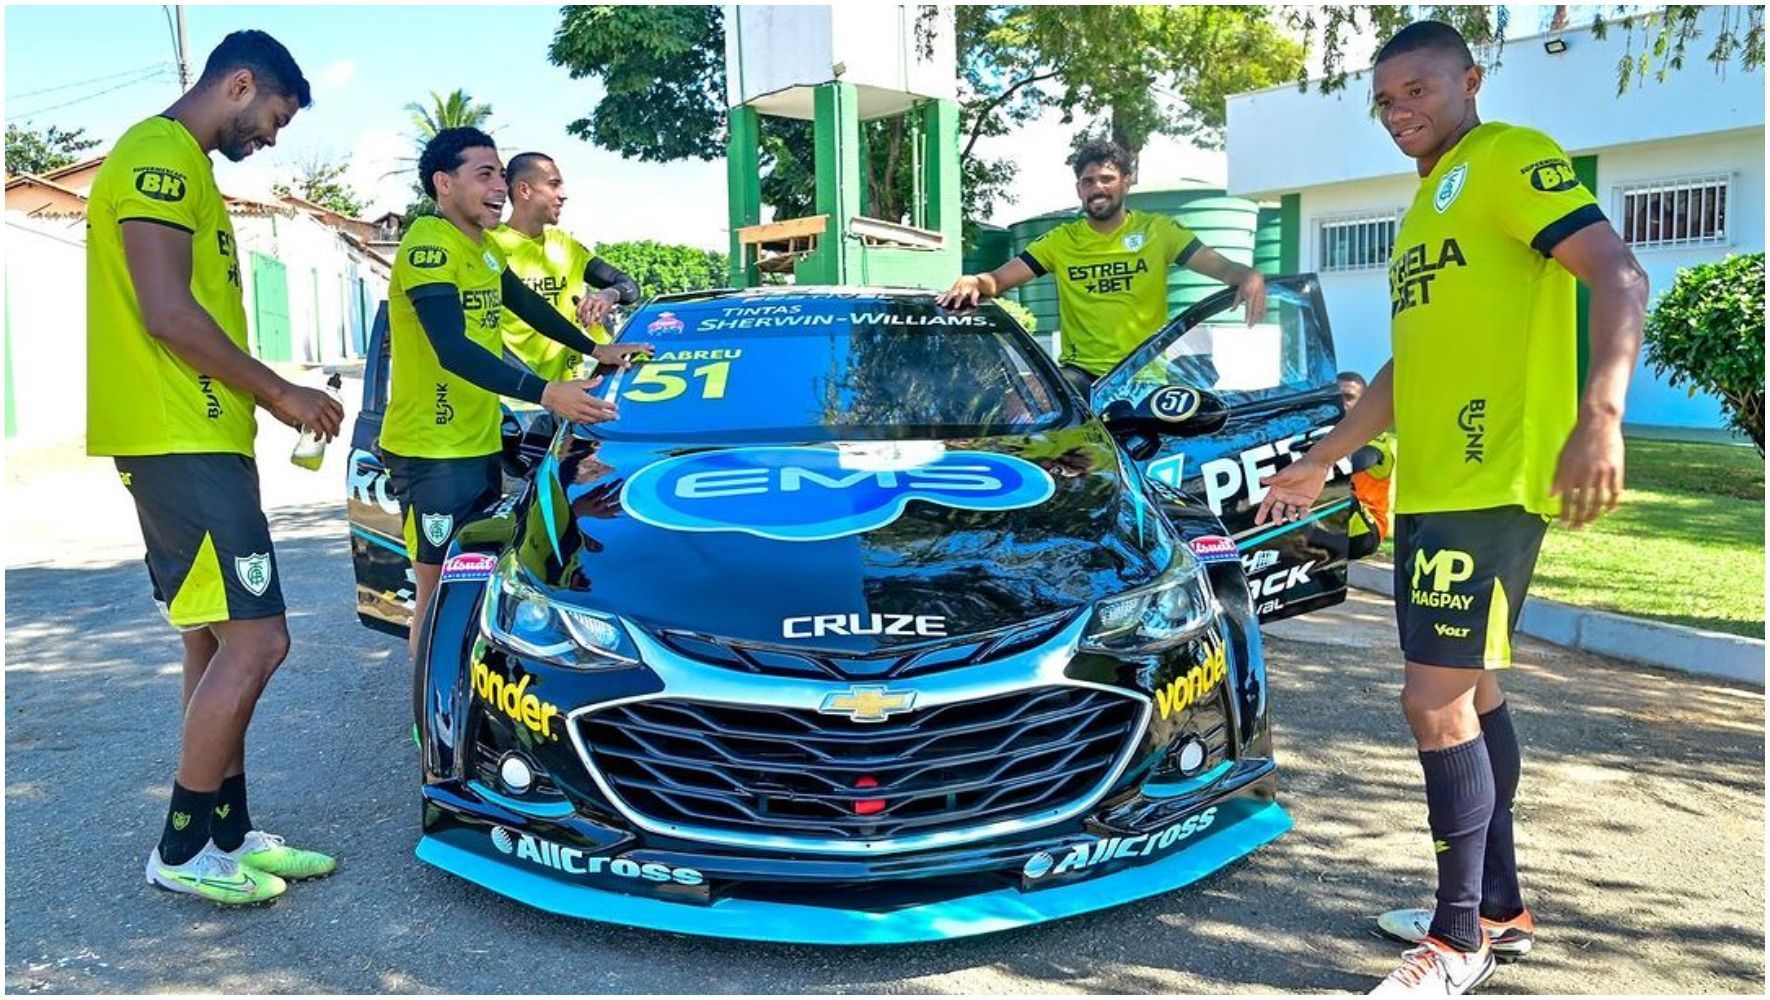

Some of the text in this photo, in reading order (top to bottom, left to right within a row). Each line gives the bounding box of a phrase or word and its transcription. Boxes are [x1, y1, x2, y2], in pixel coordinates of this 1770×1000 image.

[141, 173, 181, 198] BH
[413, 250, 442, 265] BH
[1067, 258, 1148, 281] ESTRELA
[1098, 275, 1134, 293] BET
[722, 304, 802, 317] TINTAS
[622, 361, 731, 402] 51
[1160, 390, 1190, 414] 51
[674, 466, 1002, 499] EMS
[1412, 549, 1474, 592] MP
[1411, 590, 1474, 611] MAGPAY
[782, 612, 947, 639] CRUZE
[1052, 806, 1218, 875] AllCross
[516, 833, 704, 885] AllCross
